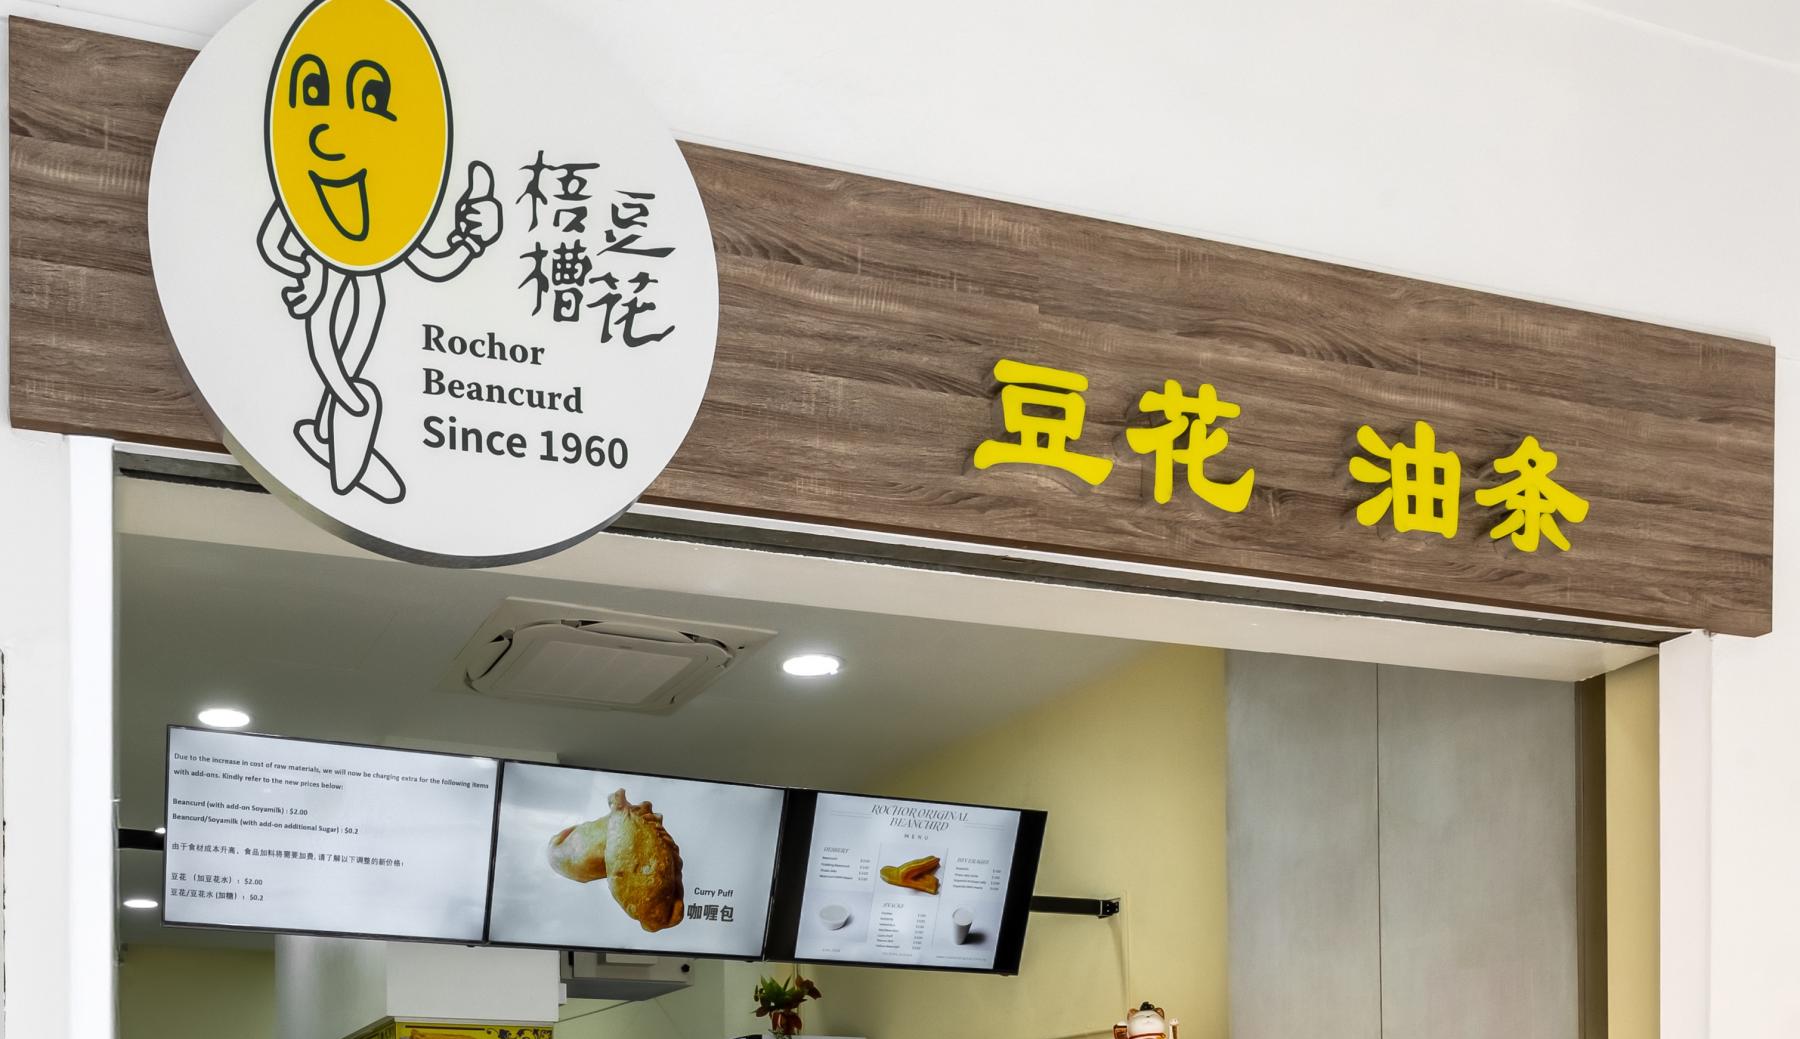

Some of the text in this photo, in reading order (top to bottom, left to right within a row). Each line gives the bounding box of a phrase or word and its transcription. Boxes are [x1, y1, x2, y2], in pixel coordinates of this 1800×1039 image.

[517, 150, 601, 323] 梧槽
[587, 190, 677, 348] 豆花
[421, 323, 545, 367] Rochor
[422, 367, 584, 414] Beancurd
[422, 415, 629, 470] Since 1960
[974, 359, 1589, 552] 豆花 油条
[174, 753, 188, 761] Due
[199, 755, 210, 763] the
[212, 756, 240, 766] increase
[250, 760, 264, 768] cost
[335, 768, 346, 776] will
[373, 772, 400, 782] charging
[441, 778, 471, 789] following
[191, 770, 220, 779] add-ons.
[222, 773, 243, 783] Kindly
[245, 775, 262, 783] refer
[272, 777, 283, 785] the
[300, 780, 320, 789] prices
[321, 782, 344, 790] below:
[172, 798, 206, 807] Beancurd
[207, 800, 225, 809] (with
[226, 803, 250, 811] add-on
[251, 805, 285, 815] Soyamilk)
[289, 807, 308, 816] $2.00
[172, 813, 239, 825] Beancurd/Soyamilk
[240, 818, 258, 828] (with
[259, 819, 283, 829] add-on
[284, 822, 317, 831] additional
[319, 825, 340, 834] Sugar)
[871, 804, 918, 818] ROCHOR
[694, 887, 734, 899] Curry Puff
[687, 903, 735, 923] 咖喱包
